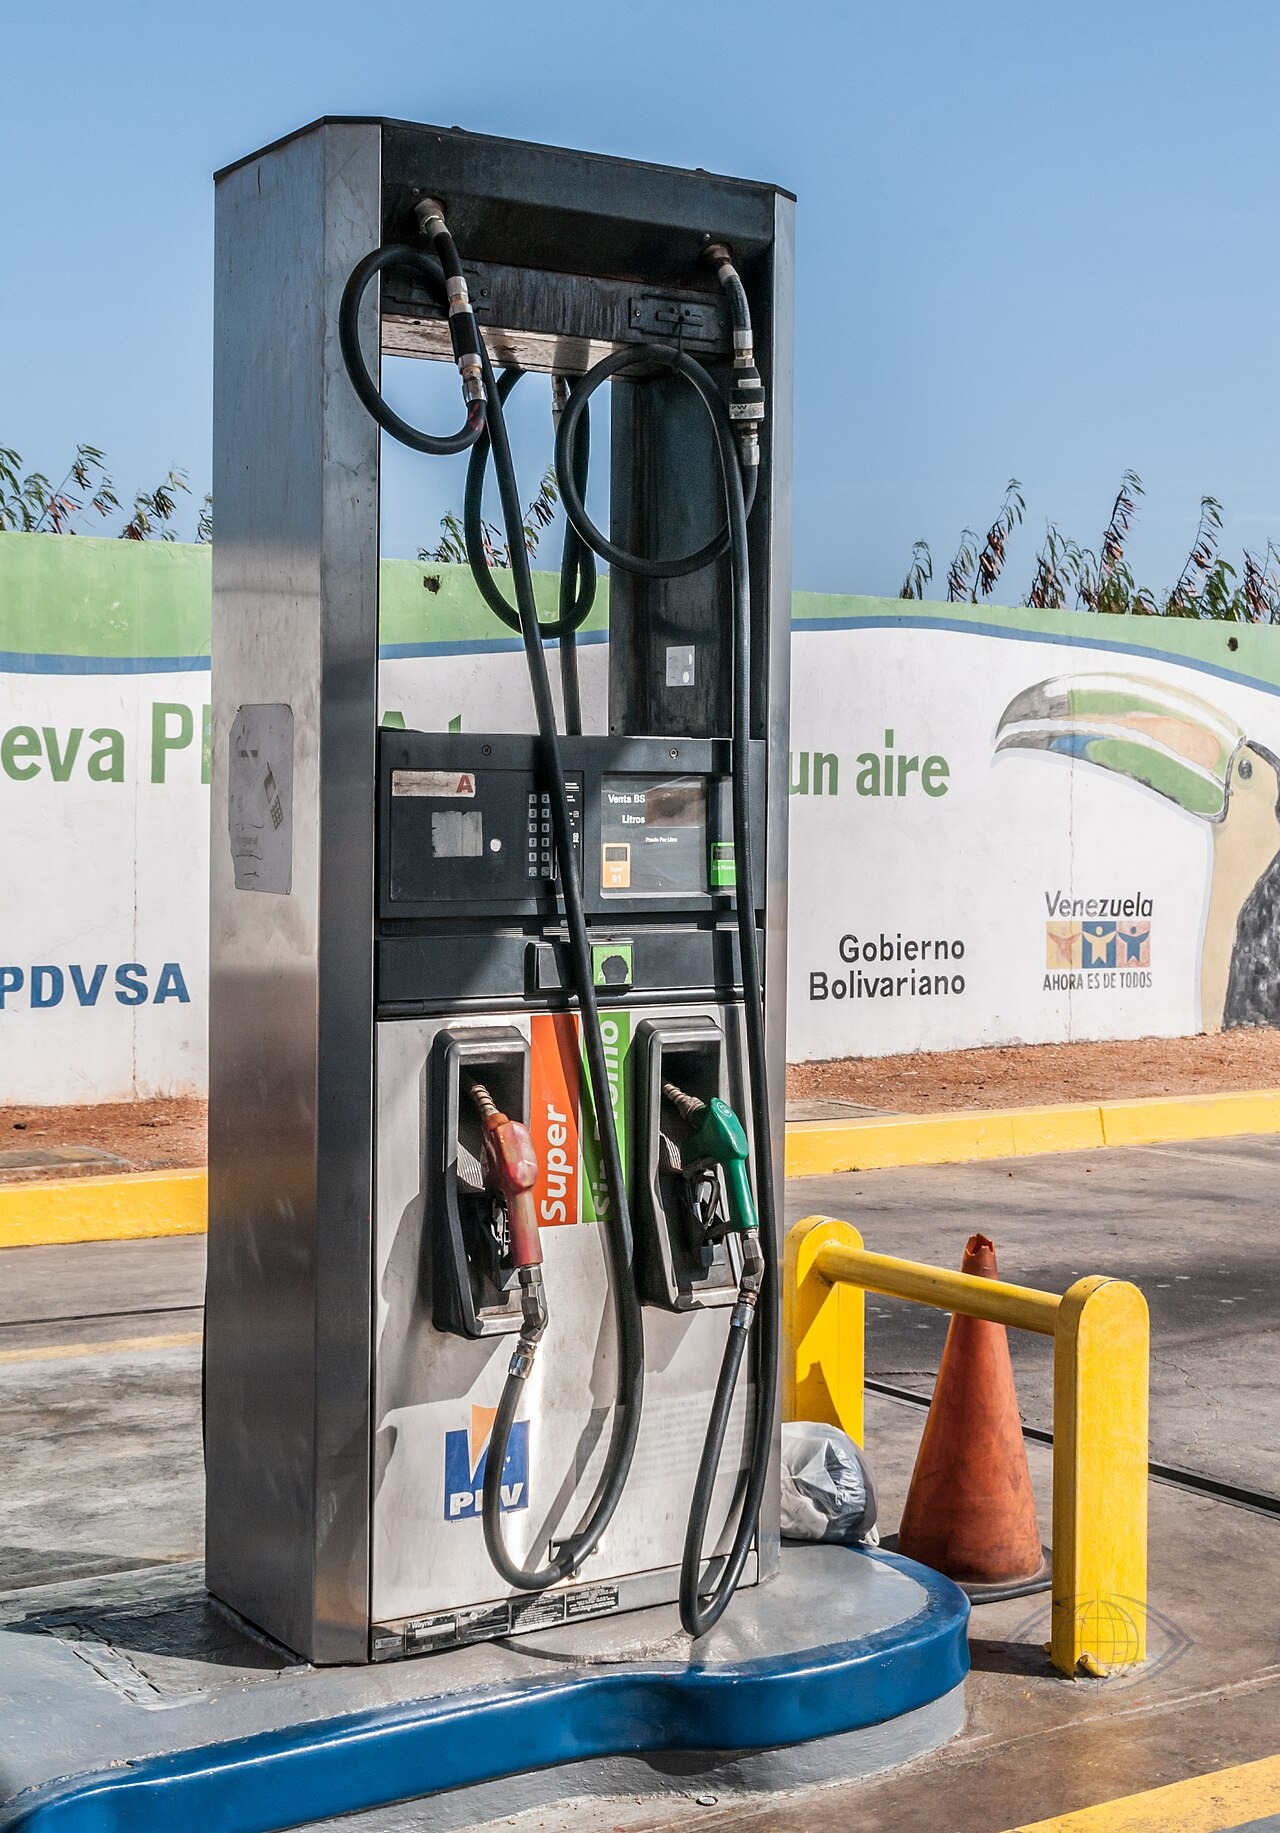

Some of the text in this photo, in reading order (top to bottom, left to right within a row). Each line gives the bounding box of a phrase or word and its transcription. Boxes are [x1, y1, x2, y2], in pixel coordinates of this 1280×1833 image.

[1, 702, 211, 784] eva P
[856, 729, 950, 797] aire
[456, 774, 473, 793] A
[608, 794, 632, 804] Venta
[621, 815, 646, 824] Litros
[1045, 890, 1153, 917] Venezuela
[839, 933, 965, 963] Gobierno
[0, 963, 190, 1009] PDVSA
[810, 968, 965, 1000] Bolivariano
[1043, 972, 1152, 991] AHORA ES DE TODOS
[541, 1103, 573, 1222] Super
